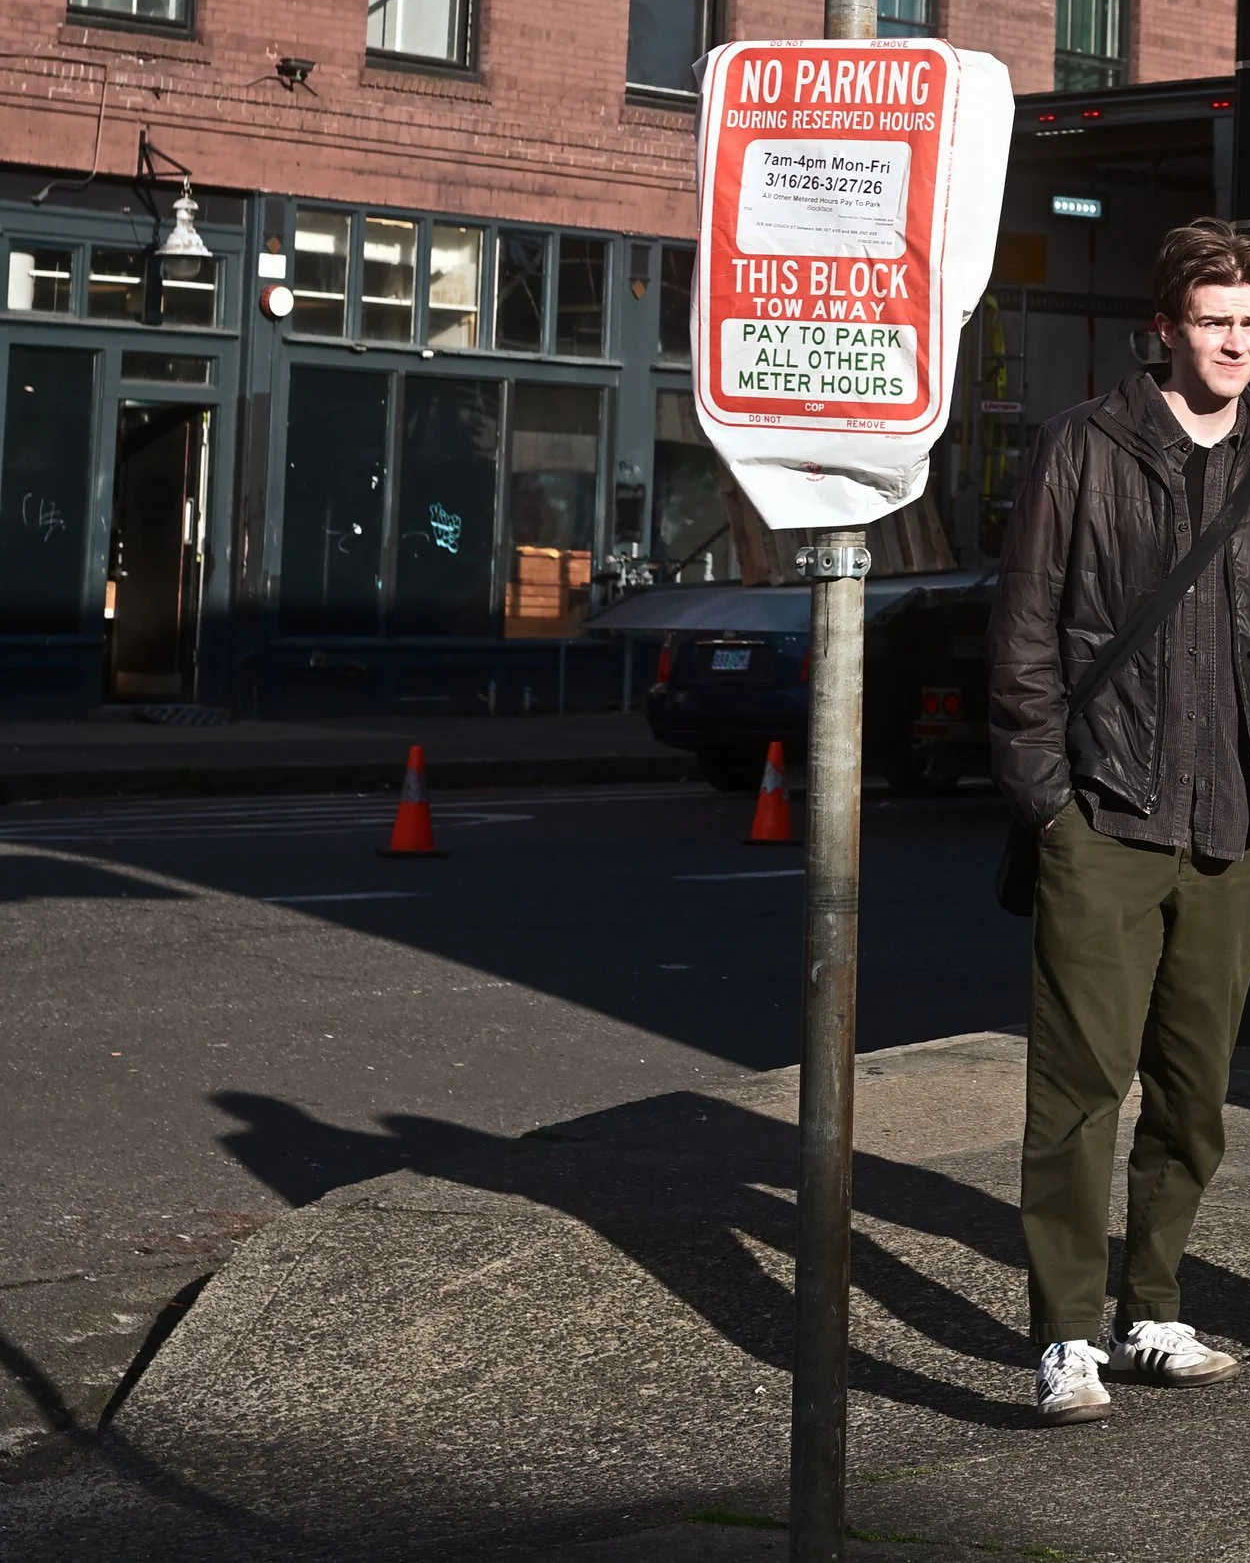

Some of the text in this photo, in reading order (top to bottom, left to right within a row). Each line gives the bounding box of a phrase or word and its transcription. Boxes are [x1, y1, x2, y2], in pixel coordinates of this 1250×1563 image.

[870, 40, 909, 48] REMOVE
[740, 59, 932, 106] NO PARKING
[726, 109, 936, 131] DURING RESERVED HOURS
[764, 152, 891, 174] 7am-4pm Mon-Fri
[765, 172, 883, 195] 3/16/26-3/27/26
[773, 193, 792, 201] Other
[793, 195, 819, 204] Metered
[819, 197, 839, 205] Hours
[840, 198, 853, 207] Pay
[855, 199, 864, 207] To
[865, 200, 881, 208] Park
[731, 258, 910, 300] THIS BLOCK
[752, 297, 887, 321] TOW AWAY
[743, 323, 902, 349] PAY TO PARK
[755, 347, 886, 372] ALL OTHER
[738, 370, 904, 397] METER HOURS
[805, 402, 825, 412] COP
[749, 414, 886, 429] DO NOT REMOVE
